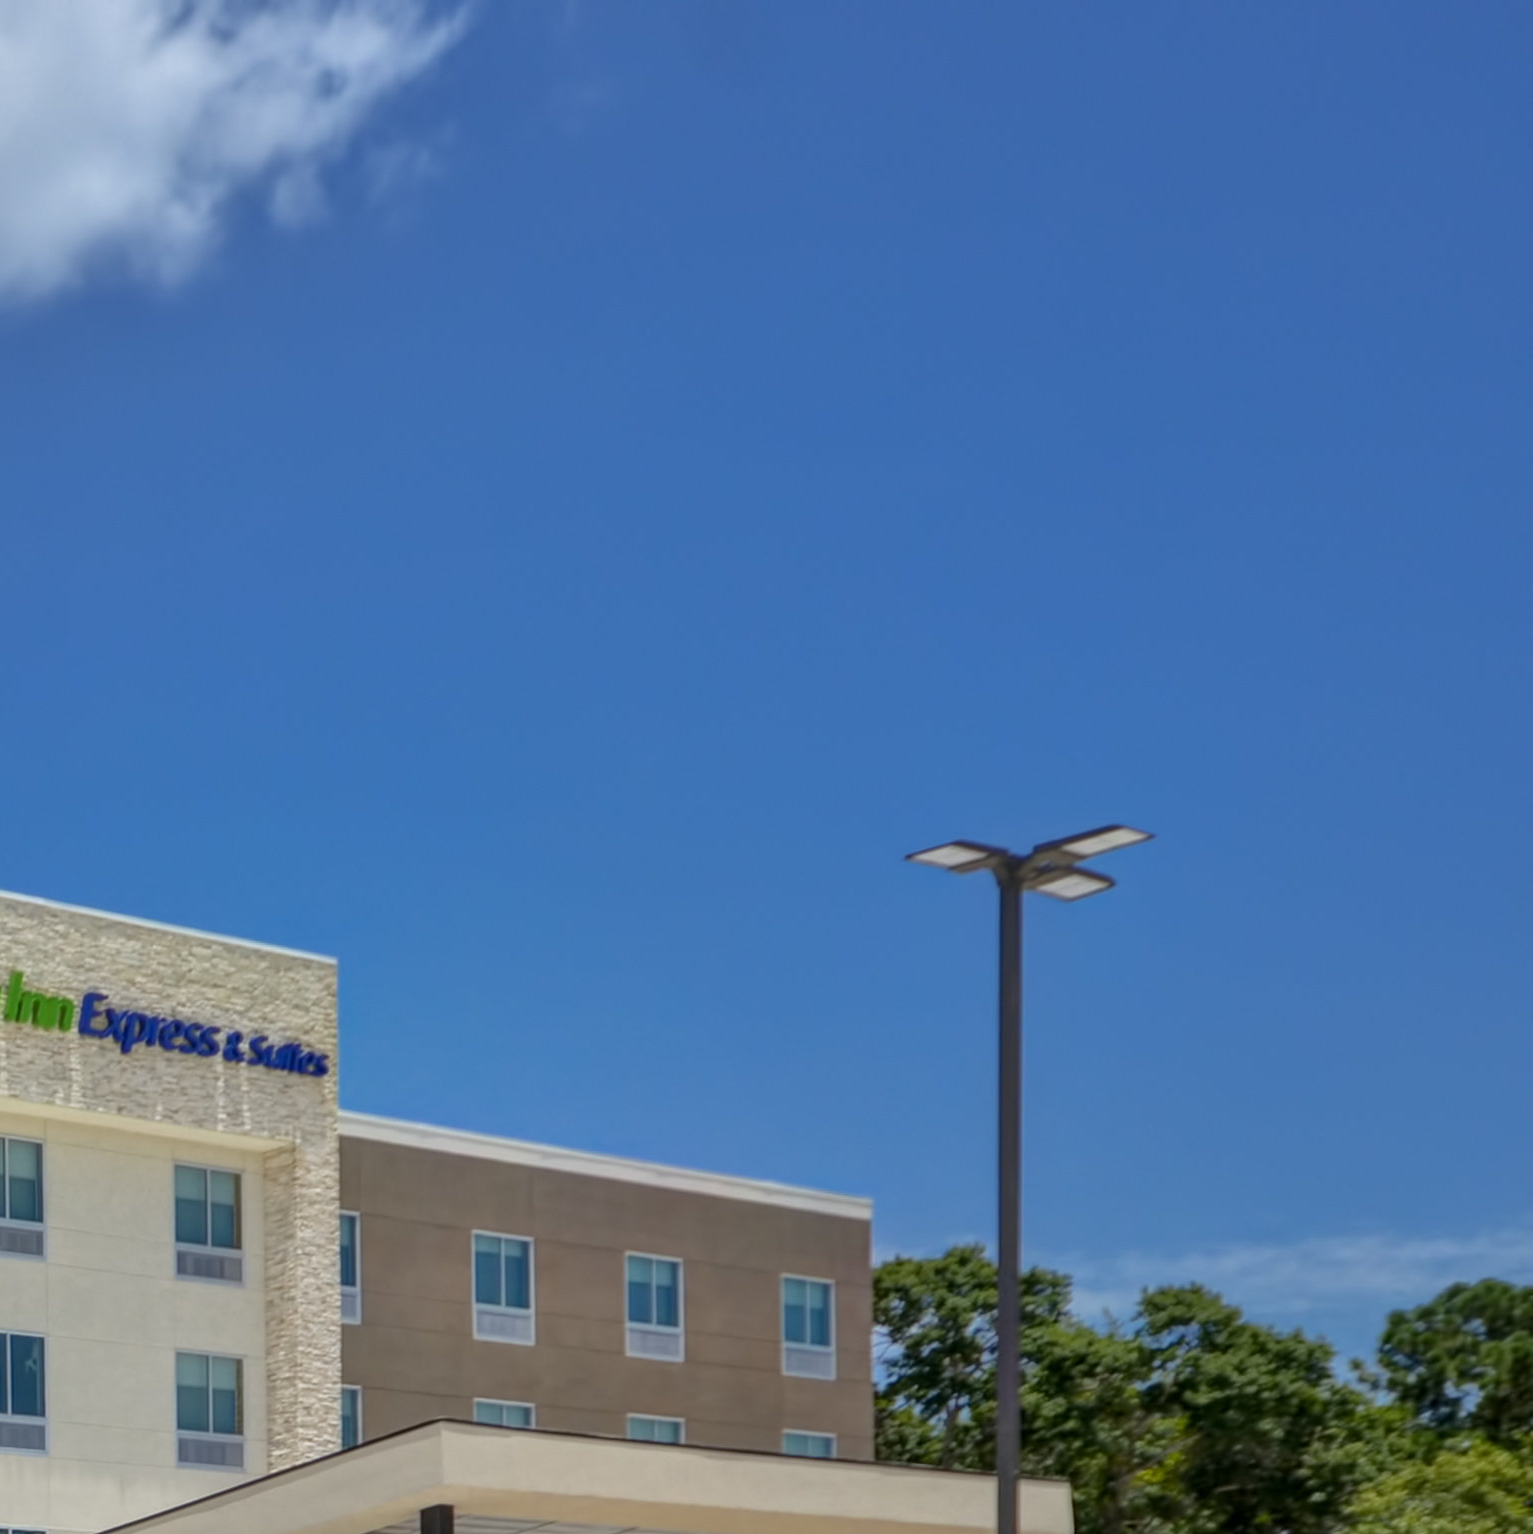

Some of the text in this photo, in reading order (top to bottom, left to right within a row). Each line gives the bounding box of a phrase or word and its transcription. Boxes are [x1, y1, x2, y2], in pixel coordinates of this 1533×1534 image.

[4, 970, 75, 1032] Inn
[78, 991, 221, 1058] Express
[222, 1030, 246, 1063] &
[246, 1035, 330, 1078] Suites
